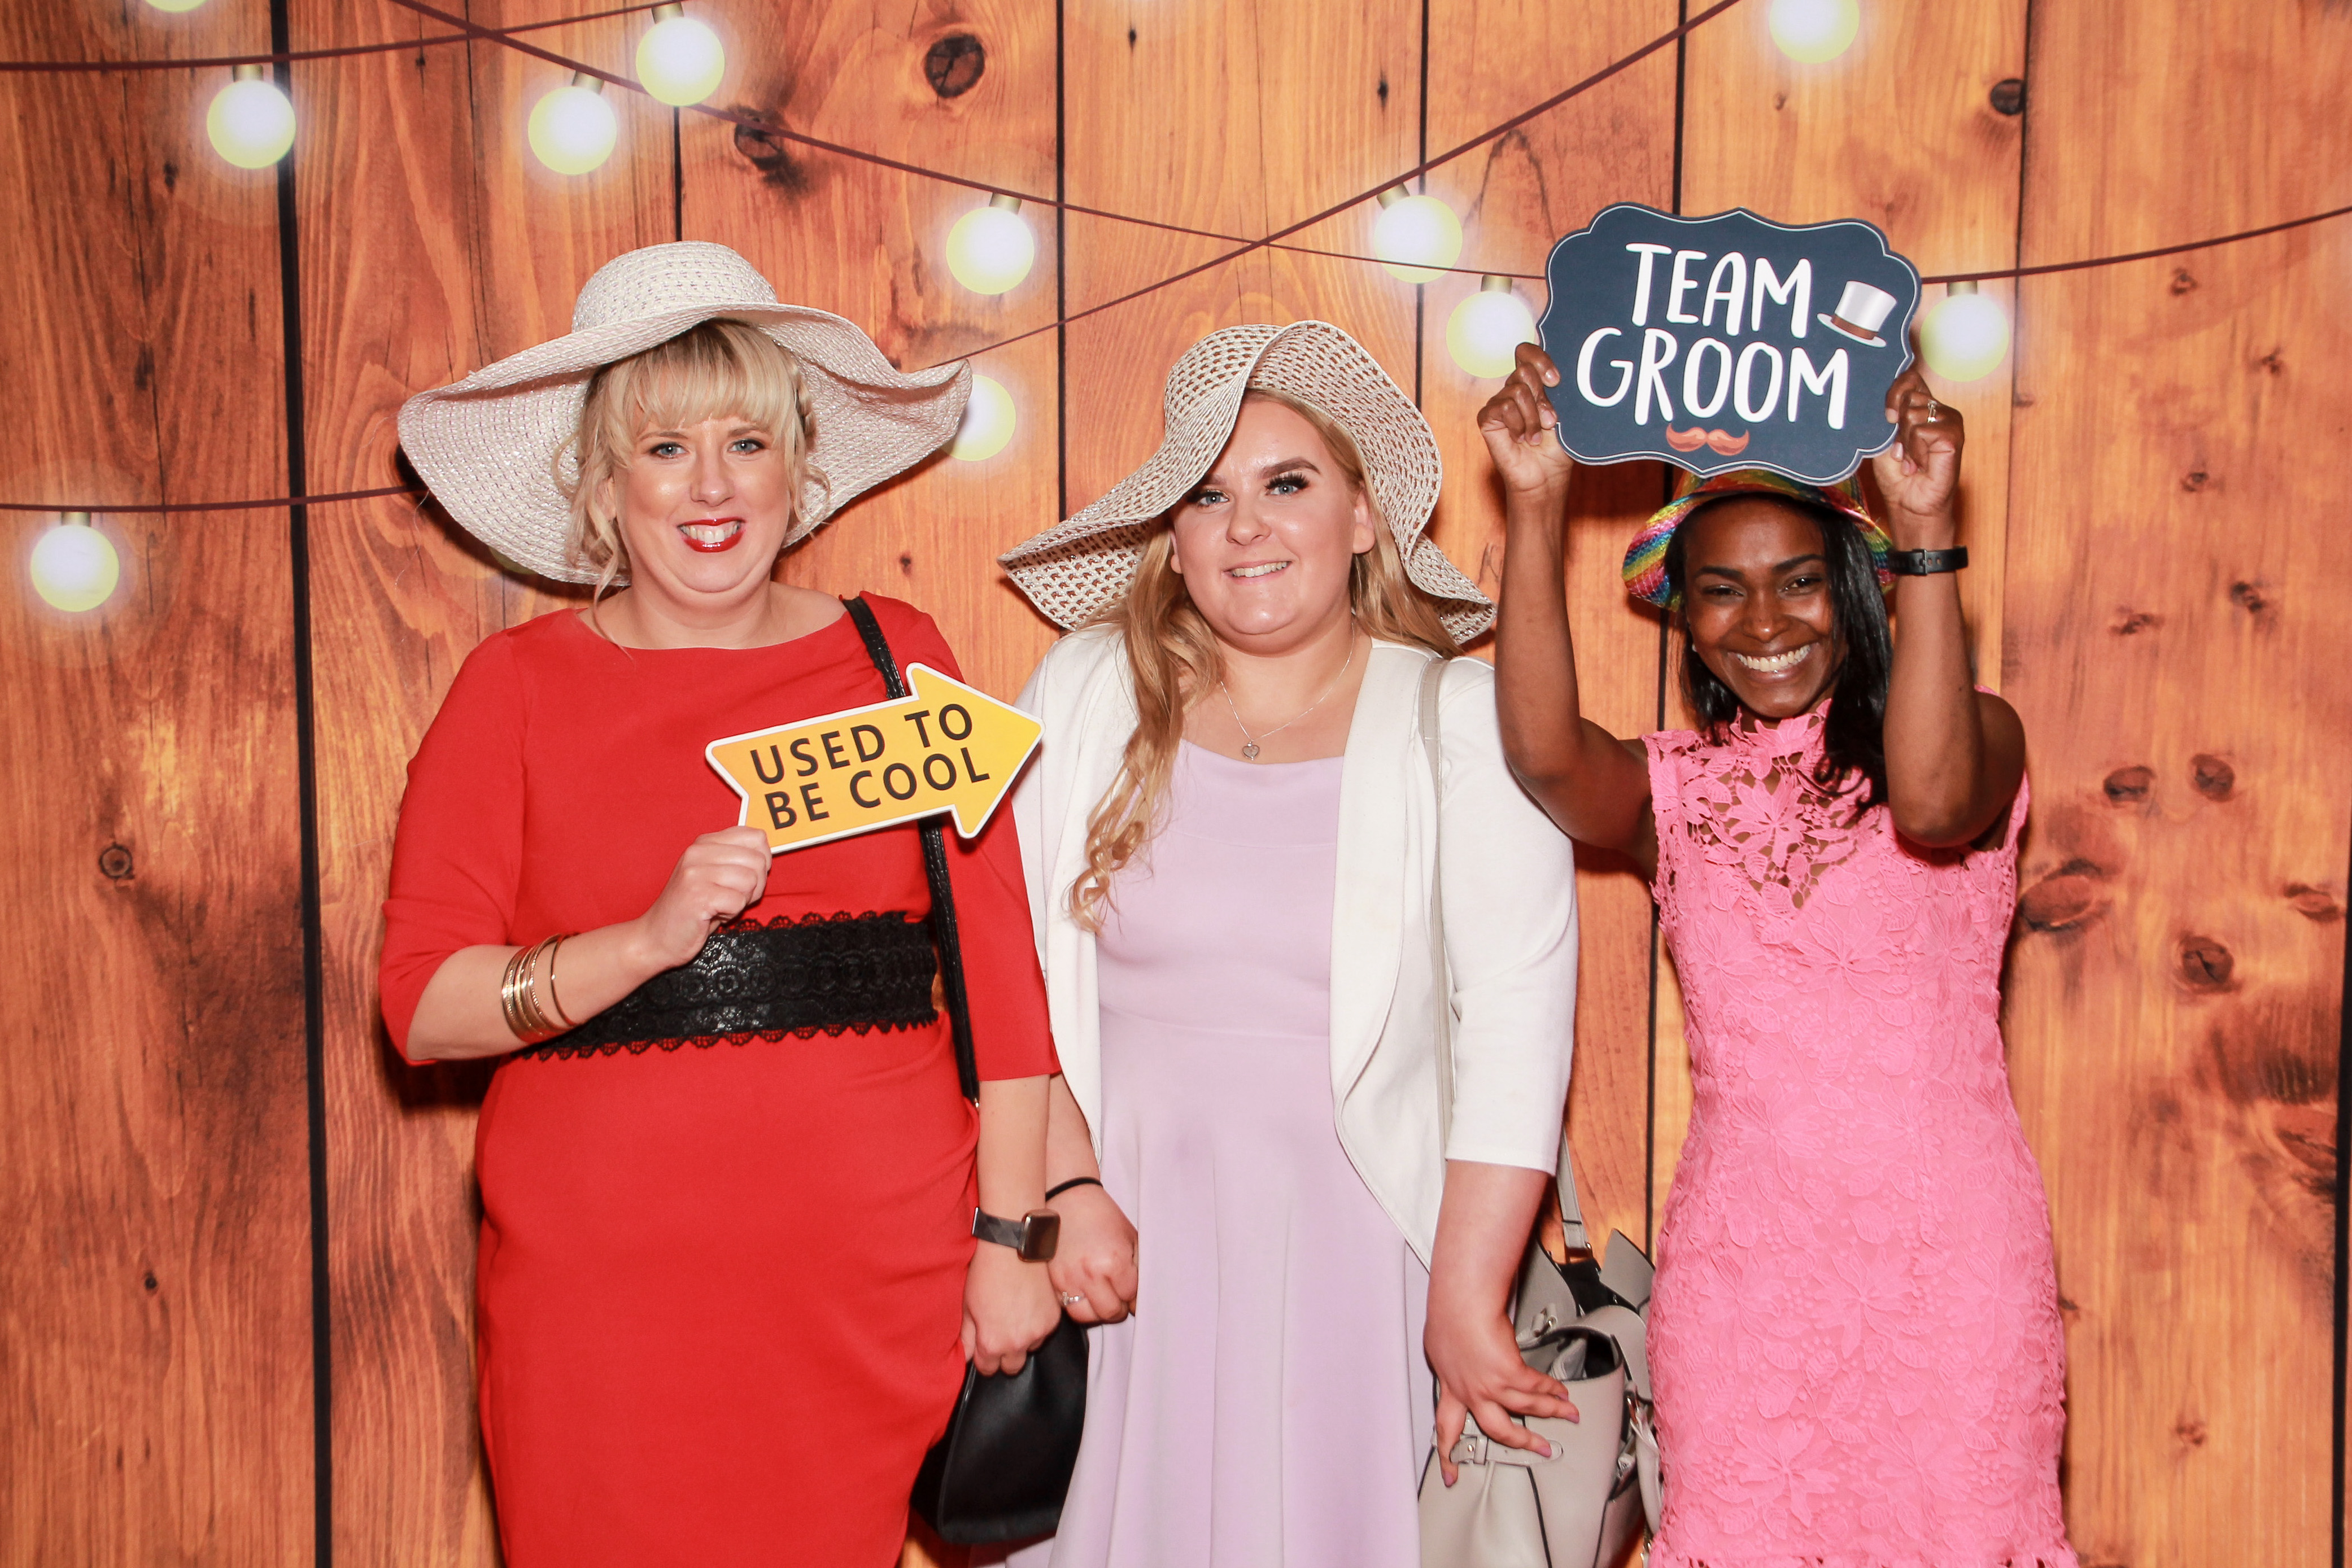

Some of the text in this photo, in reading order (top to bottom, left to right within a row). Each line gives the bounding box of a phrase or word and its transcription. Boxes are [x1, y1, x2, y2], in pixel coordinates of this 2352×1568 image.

[1625, 243, 1812, 338] TEAM
[1576, 327, 1848, 430] GROOM
[750, 704, 972, 784] USED TO
[765, 747, 990, 829] BE COOL
